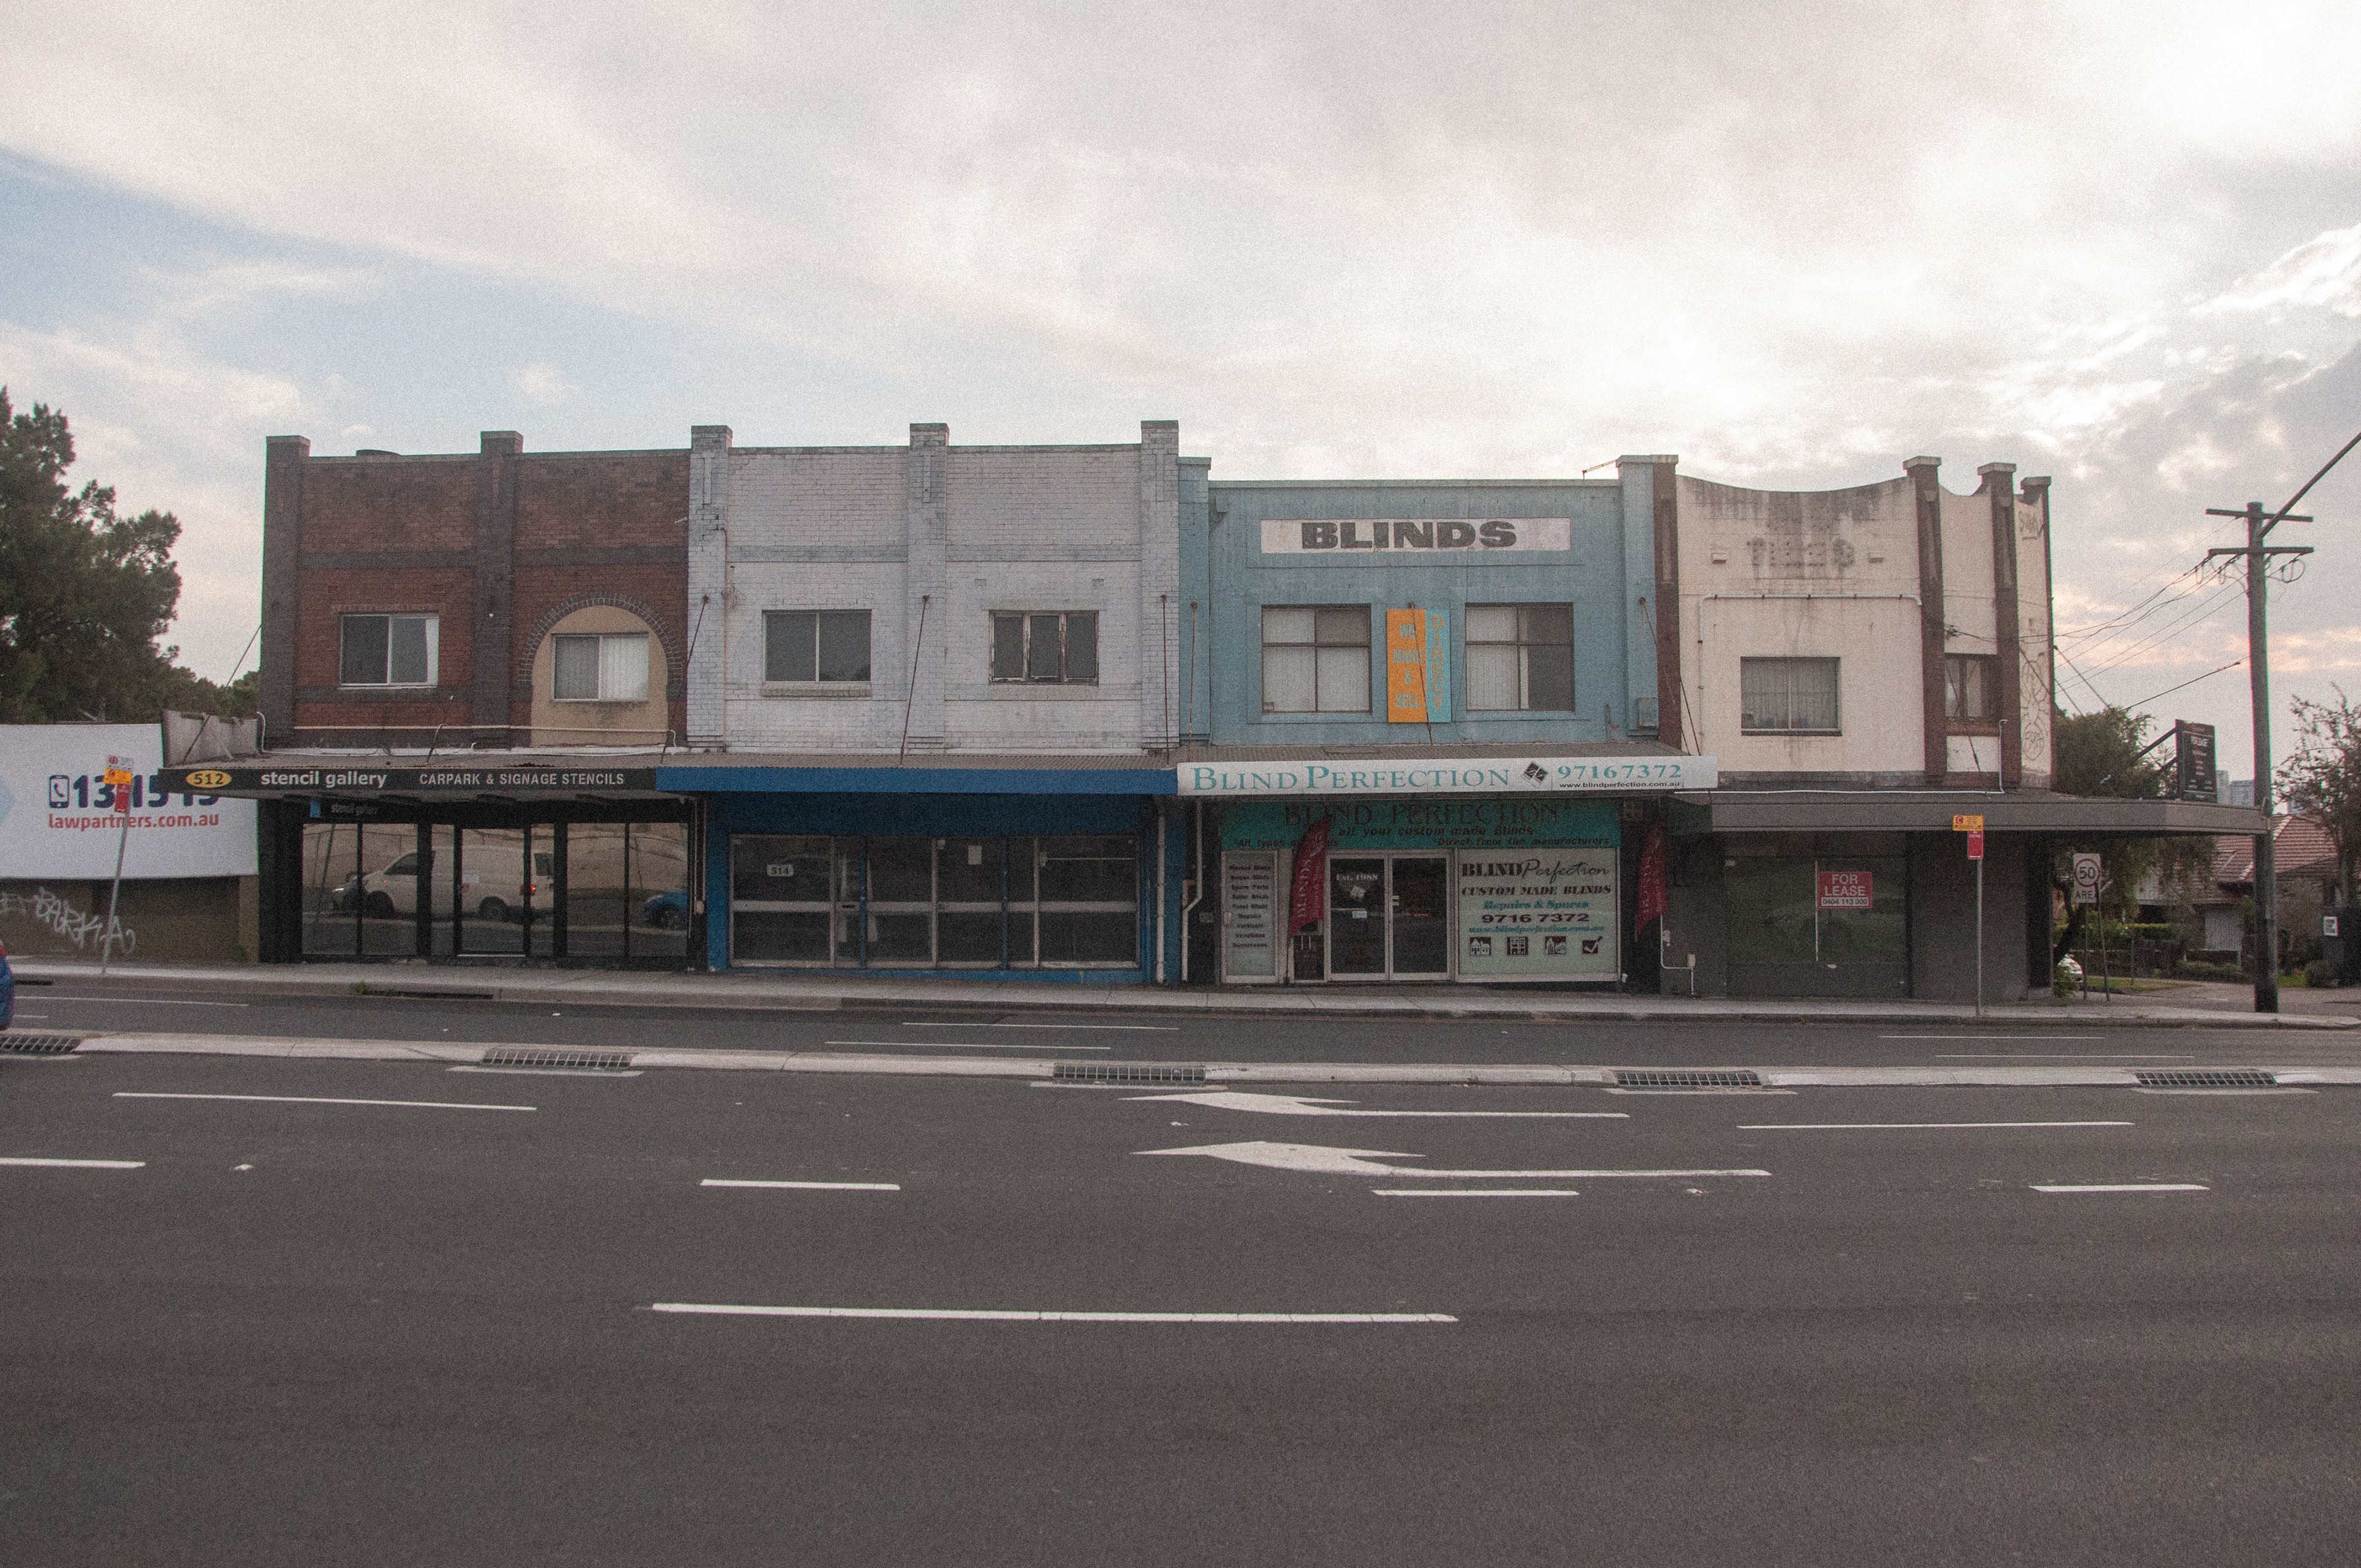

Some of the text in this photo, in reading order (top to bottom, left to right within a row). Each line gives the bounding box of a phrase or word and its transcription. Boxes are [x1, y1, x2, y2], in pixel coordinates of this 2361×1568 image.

[1302, 521, 1517, 549] BLINDS
[1399, 624, 1415, 638] WE
[1393, 649, 1423, 663] MAKE
[1431, 614, 1444, 711] DIRECT
[1404, 669, 1412, 684] &
[1396, 692, 1420, 708] SELL
[194, 773, 224, 784] 512
[261, 770, 387, 788] stencil gallery
[419, 773, 625, 785] CARPARK & SIGNAGE STENCILS
[1191, 766, 1509, 791] BLIND PERFECTION
[73, 775, 115, 808] 13
[49, 814, 219, 831] lawpartners.com.au
[1363, 828, 1393, 837] your
[1397, 826, 1445, 836] custom
[1462, 858, 1609, 884] BLIND Perfection
[2079, 866, 2096, 879] 50
[1832, 874, 1859, 885] FOR
[1462, 885, 1612, 896] CUSTOM MADE BLINDS
[1824, 885, 1866, 897] LEASE
[2075, 890, 2095, 899] ARE
[1484, 900, 1589, 910] Repairs & Spares
[1481, 913, 1589, 923] 9716 7372
